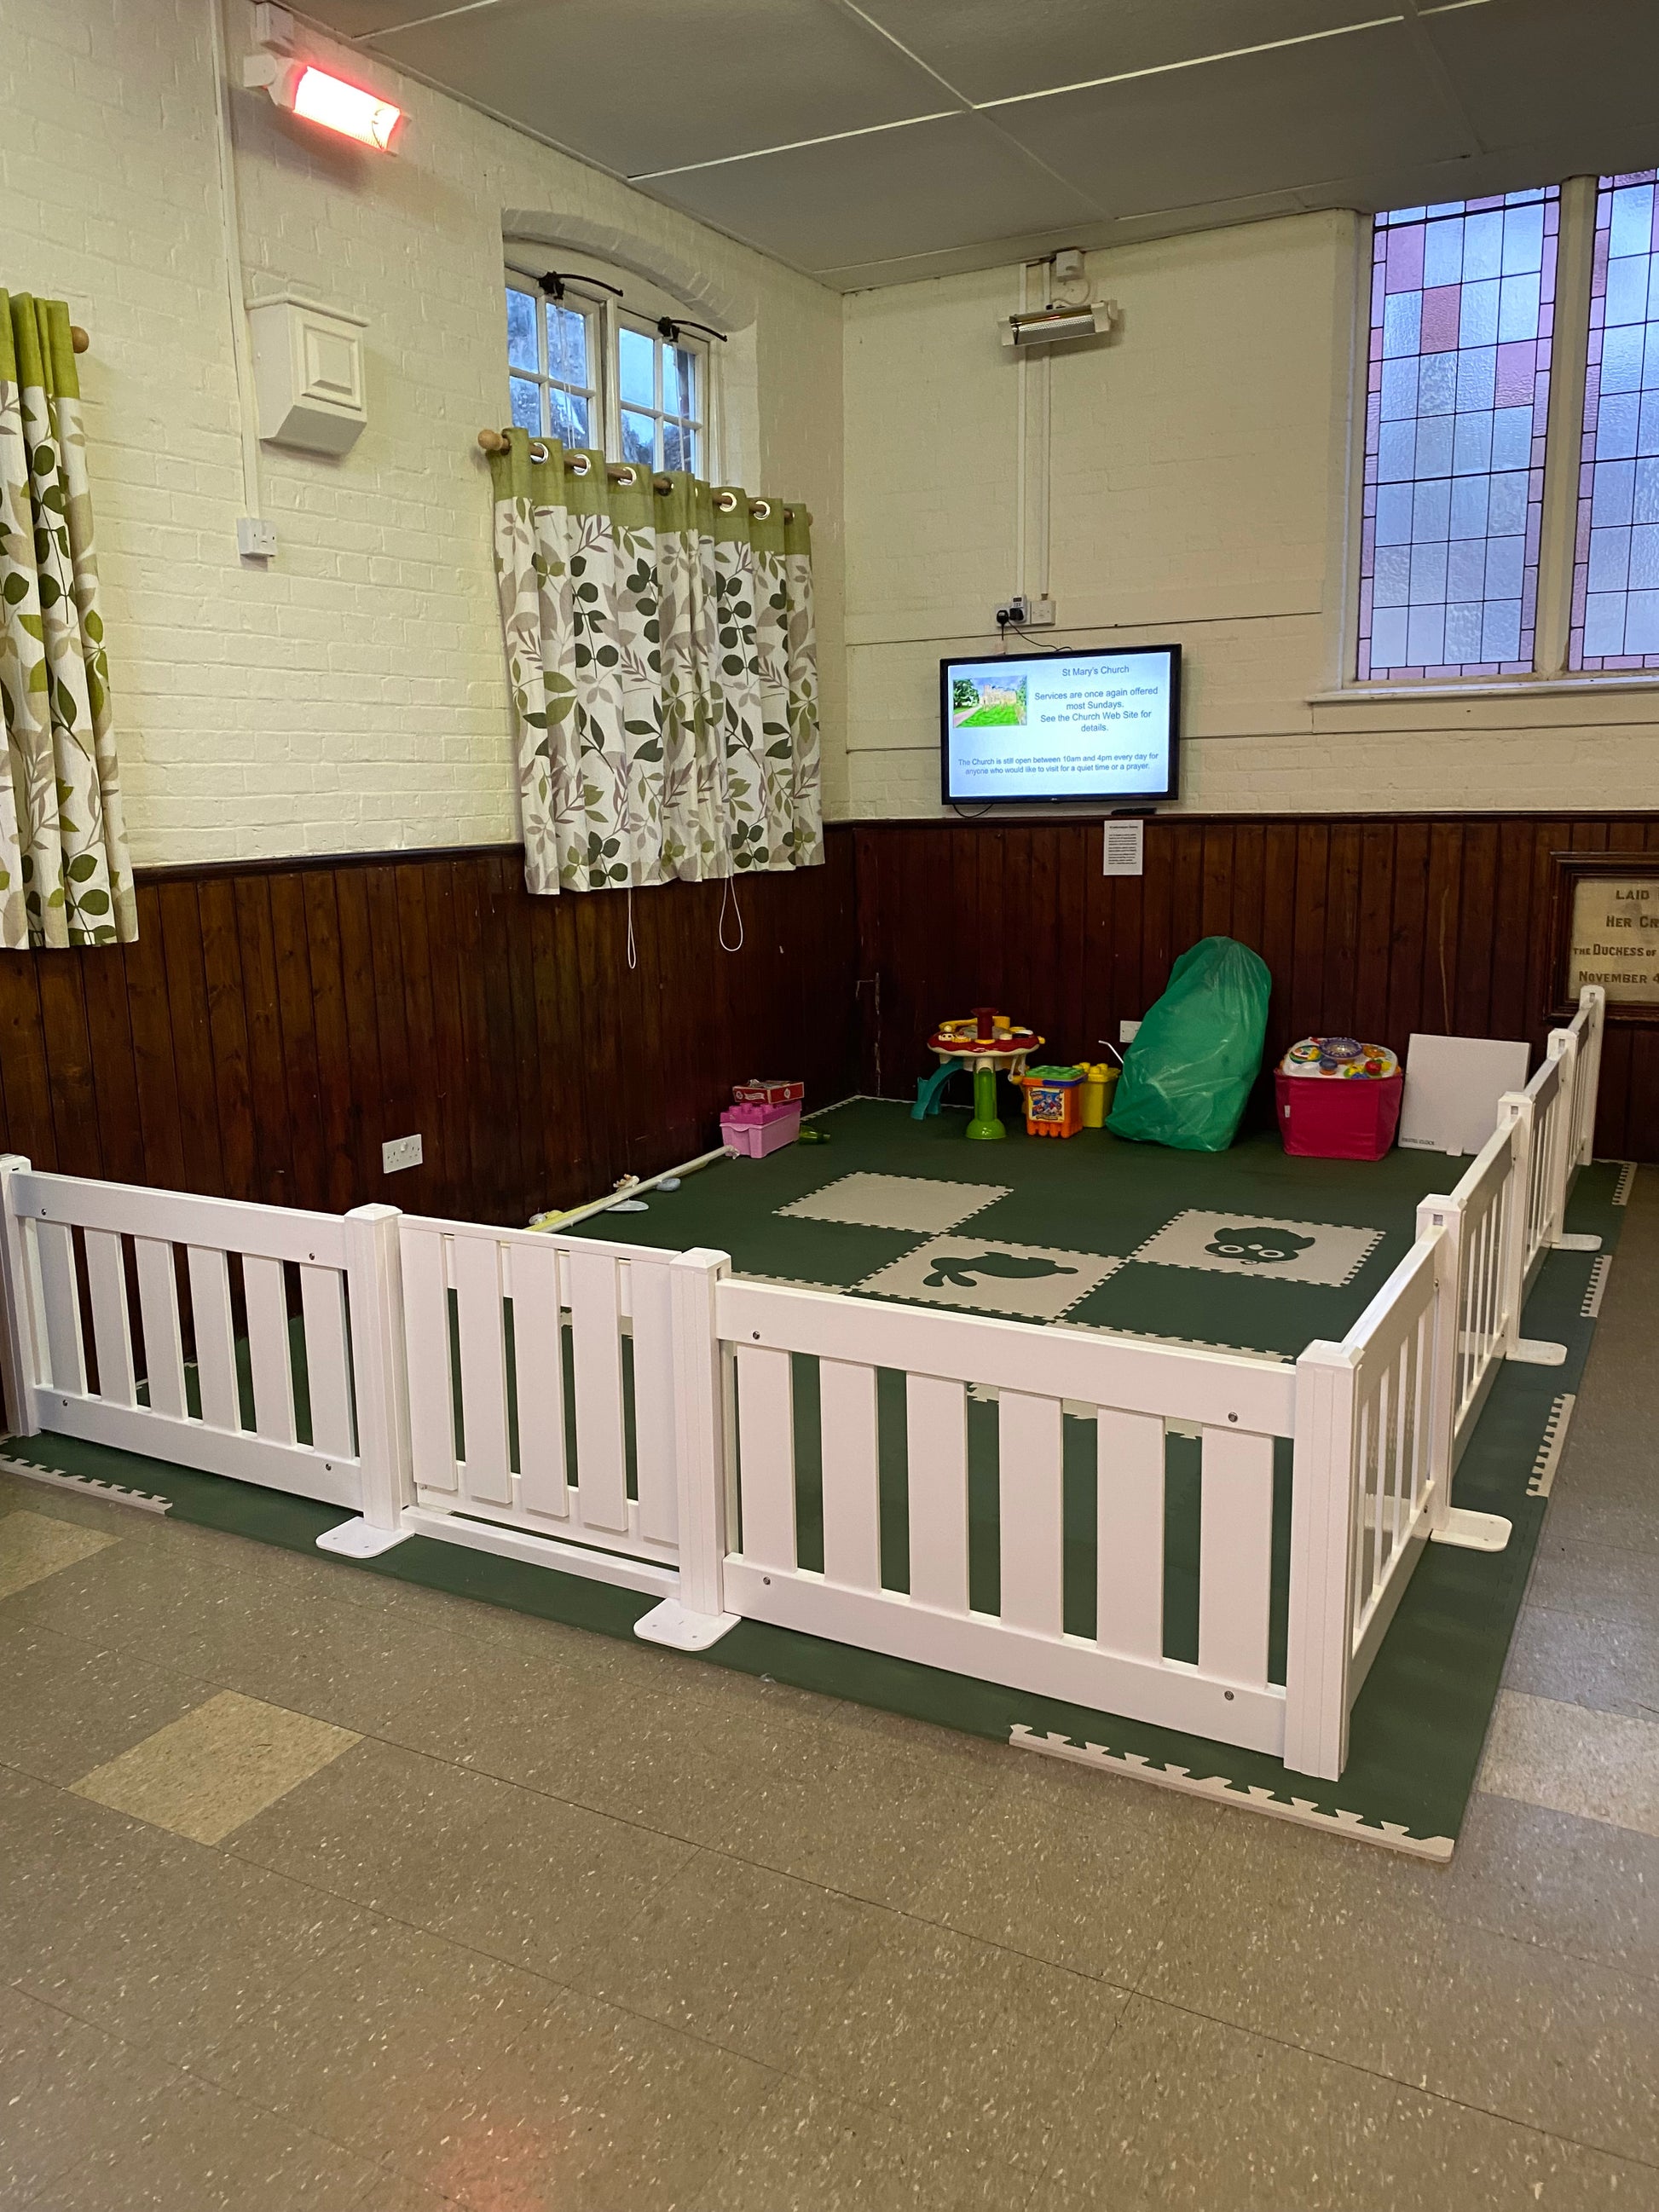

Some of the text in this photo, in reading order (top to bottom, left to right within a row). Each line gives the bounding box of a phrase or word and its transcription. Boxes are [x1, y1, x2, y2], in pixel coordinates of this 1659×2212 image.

[1061, 665, 1130, 677] St Mary's Church
[1034, 691, 1067, 701] Services
[1106, 688, 1128, 698] again
[1130, 686, 1159, 696] offered
[1066, 700, 1124, 710] most Sundays.
[1040, 709, 1152, 723] See the Church Web Site for
[1081, 724, 1108, 732] details.
[1616, 890, 1650, 900] LAID
[1606, 915, 1633, 928] HER
[1593, 944, 1645, 956] DUCHESS
[1579, 971, 1647, 984] NOVEMBER
